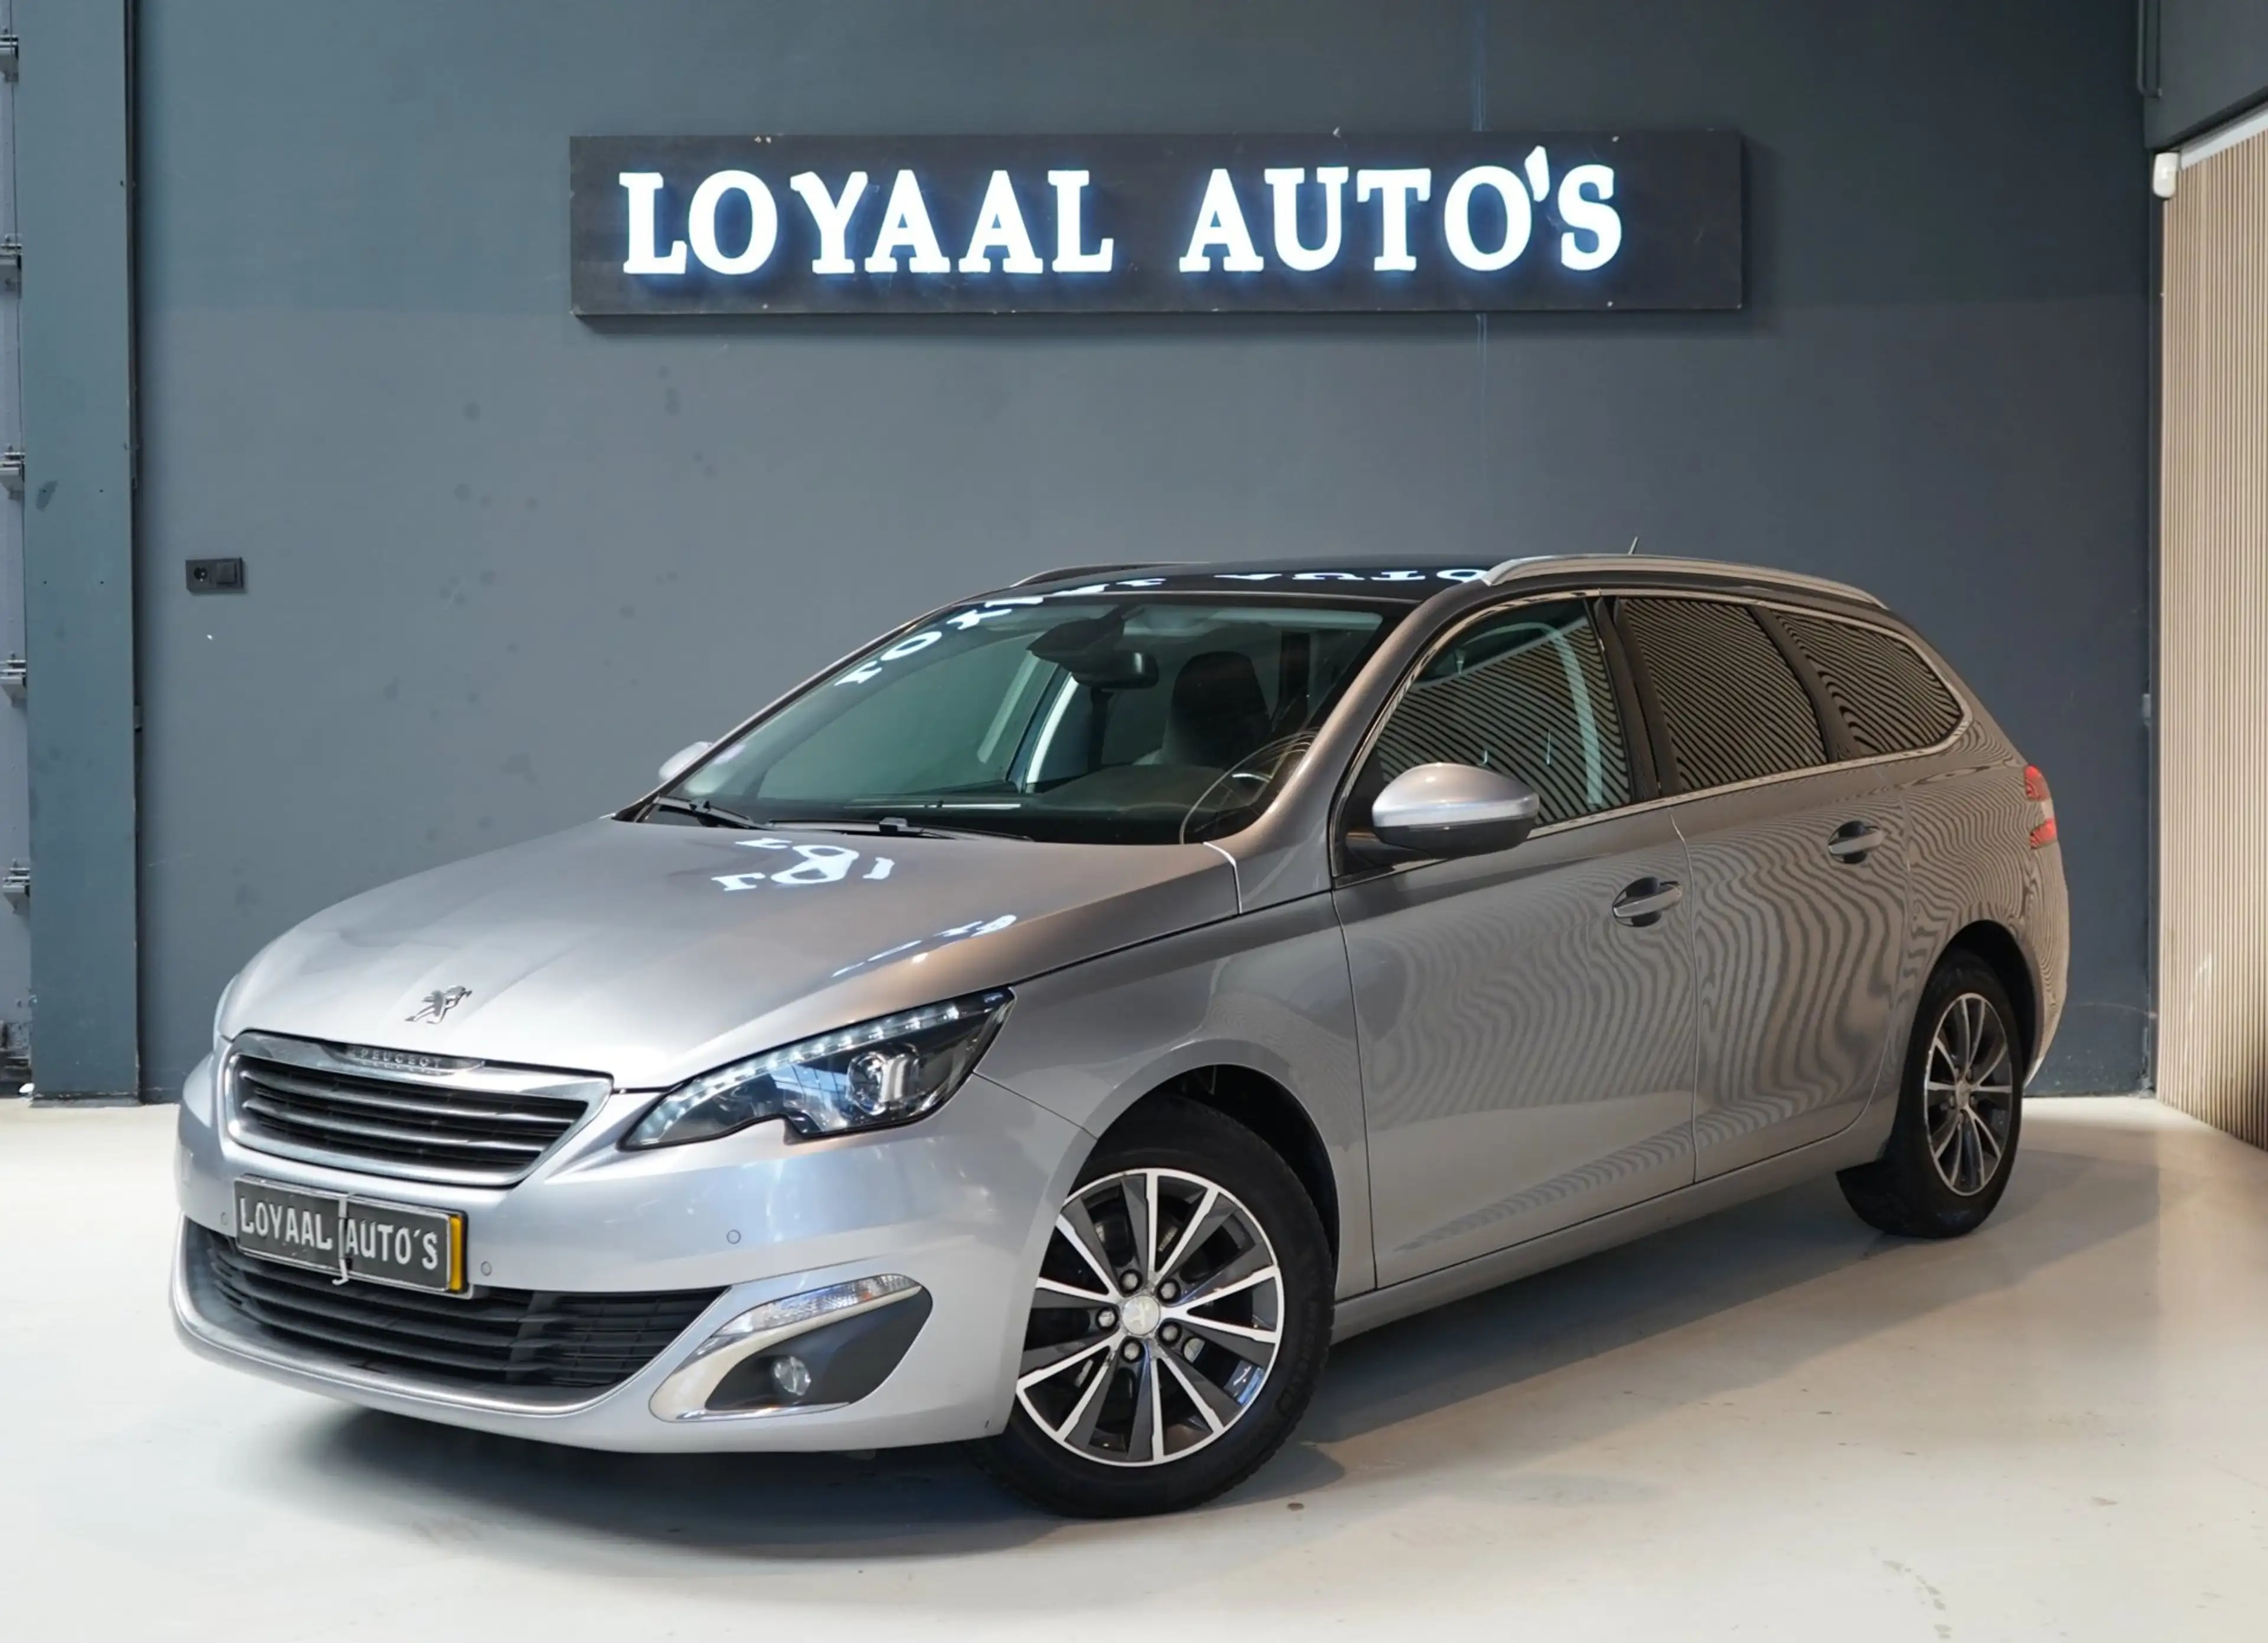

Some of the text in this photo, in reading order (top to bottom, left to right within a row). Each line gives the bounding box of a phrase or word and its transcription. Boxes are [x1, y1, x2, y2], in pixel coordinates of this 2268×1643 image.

[618, 145, 1623, 275] LOYAAL AUTO'S
[360, 1047, 442, 1069] PEUGEOT
[239, 1198, 439, 1271] LOYAAL AUTO'S
